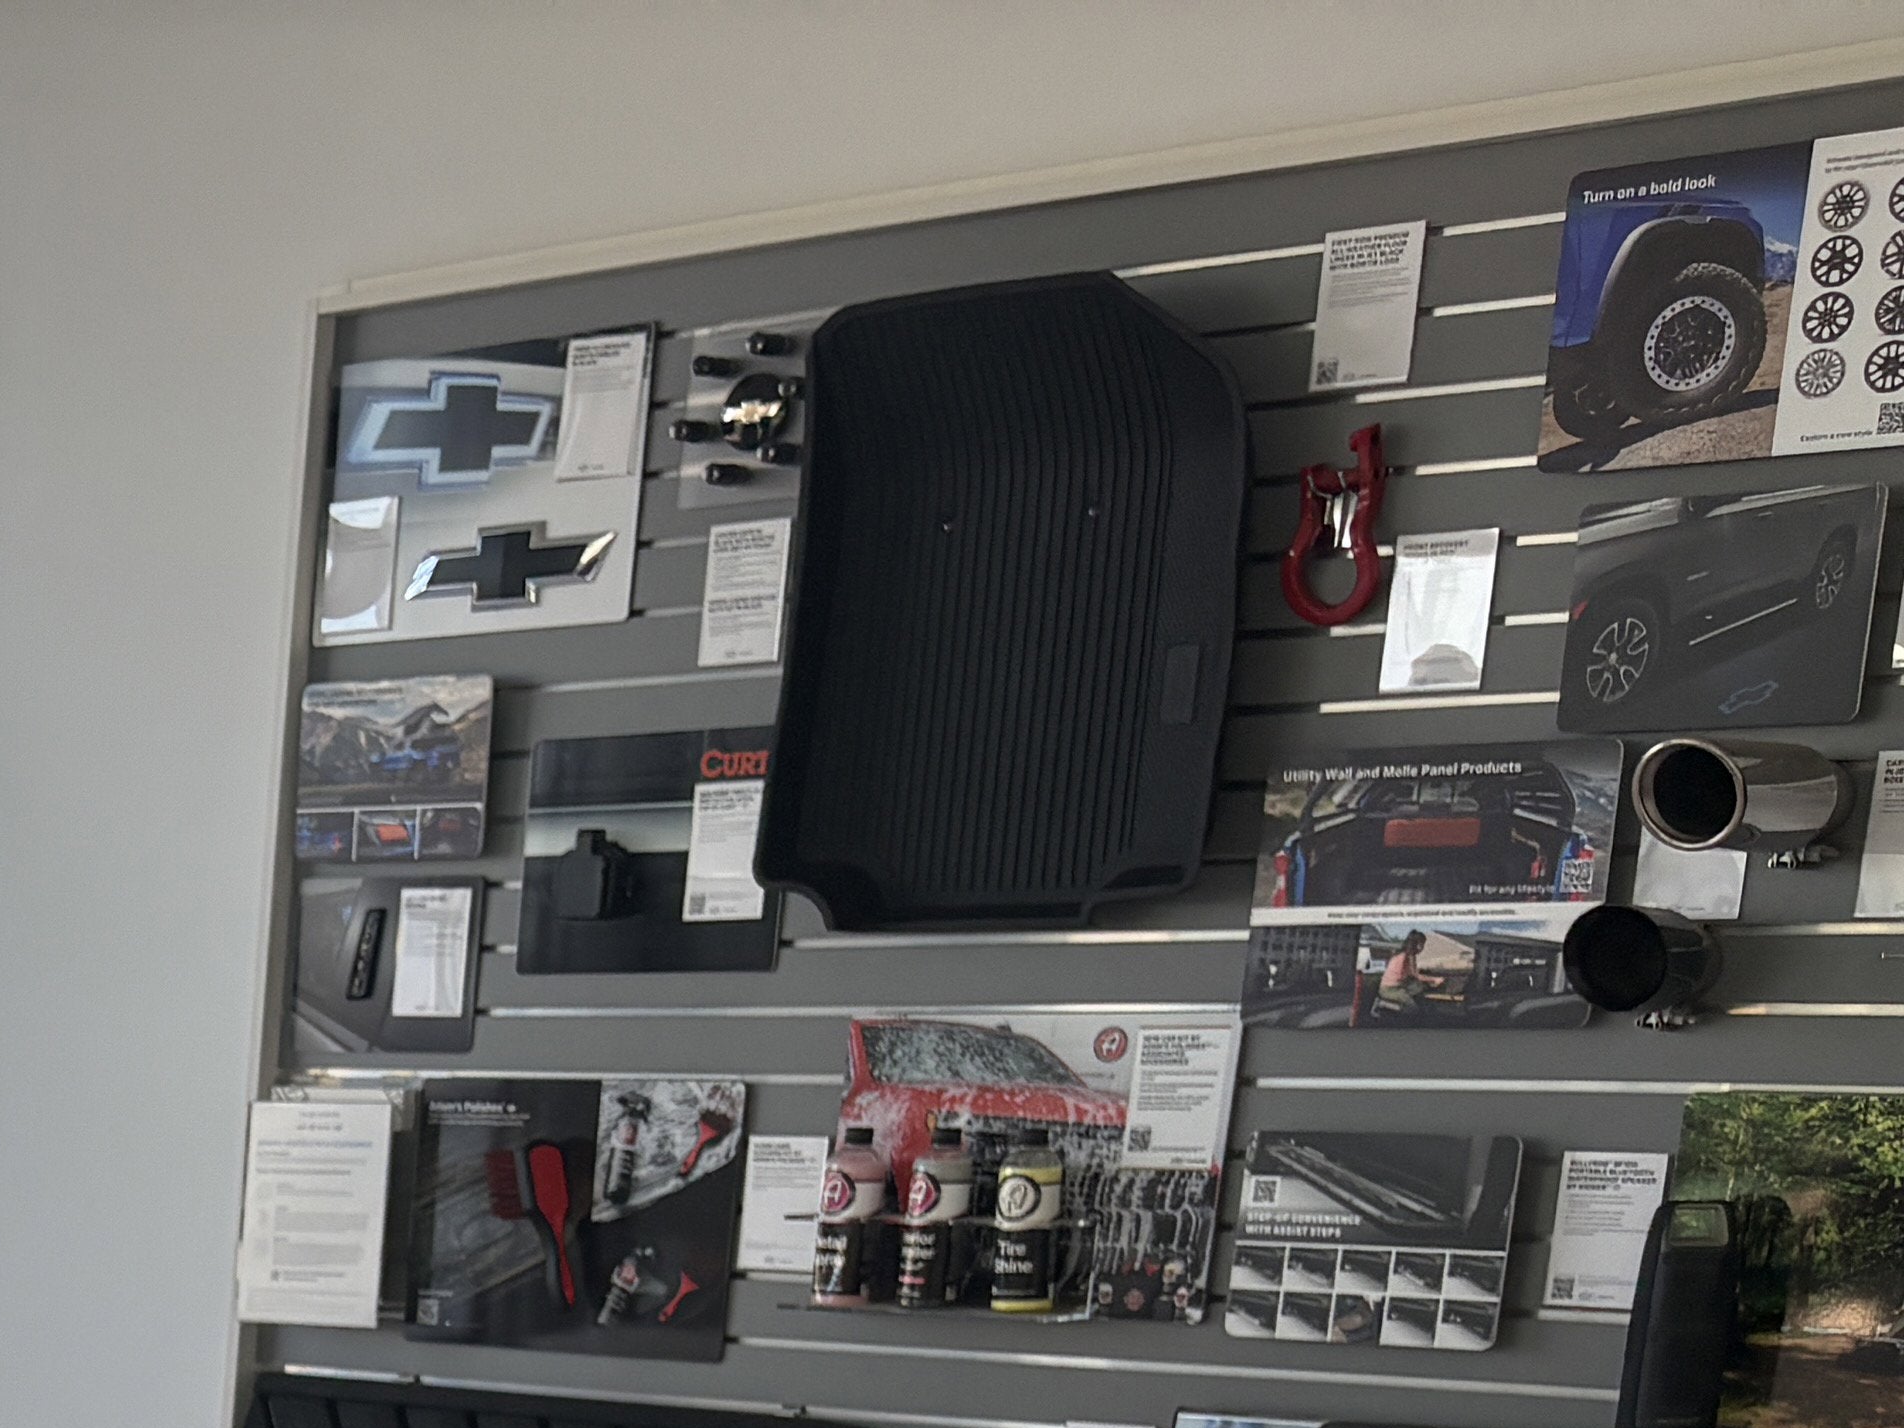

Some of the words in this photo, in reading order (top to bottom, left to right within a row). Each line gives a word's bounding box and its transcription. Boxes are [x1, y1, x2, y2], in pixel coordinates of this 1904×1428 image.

[1583, 189, 1614, 204] Turn
[1617, 187, 1634, 200] on
[1638, 186, 1646, 197] a
[1650, 177, 1682, 195] bold
[1684, 173, 1717, 190] look
[1283, 769, 1321, 783] Utility
[1325, 767, 1353, 781] Wall
[1356, 766, 1380, 779] and
[1421, 762, 1458, 776] Panel
[1461, 761, 1522, 775] Products
[1246, 1223, 1271, 1234] WITH
[1273, 1225, 1308, 1237] ASSIST
[1310, 1226, 1341, 1238] STEPS
[998, 1239, 1026, 1257] Tire
